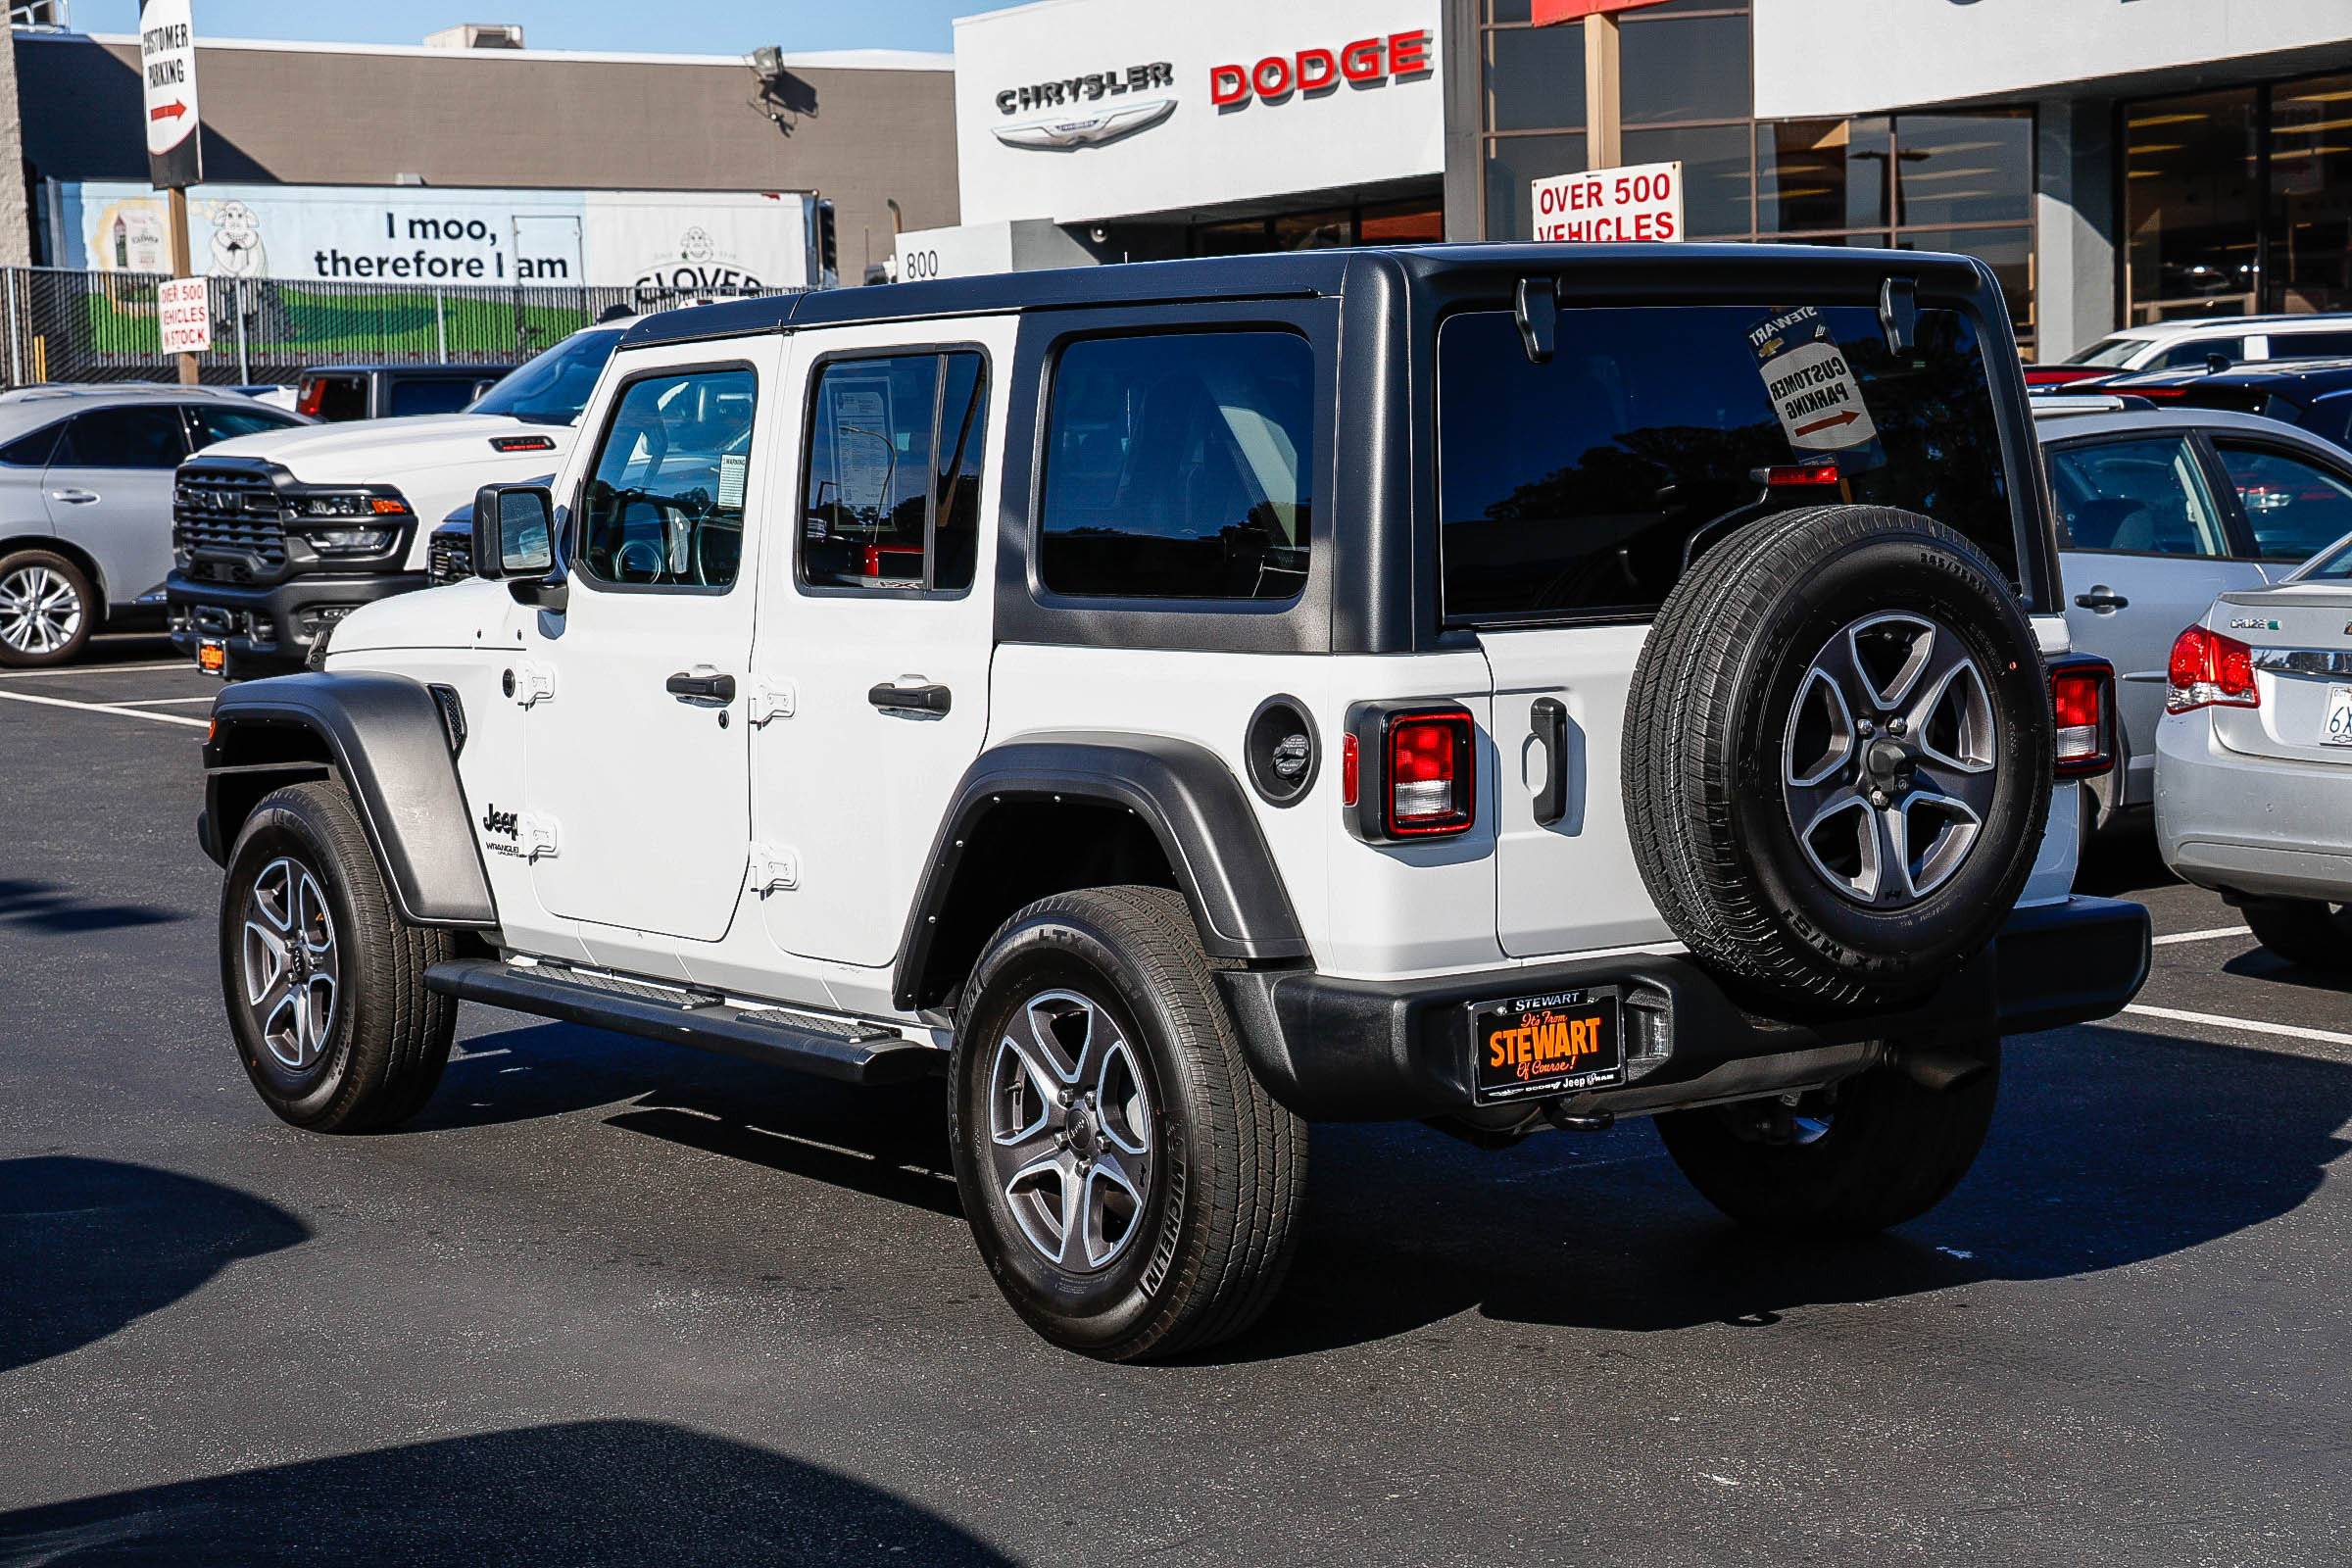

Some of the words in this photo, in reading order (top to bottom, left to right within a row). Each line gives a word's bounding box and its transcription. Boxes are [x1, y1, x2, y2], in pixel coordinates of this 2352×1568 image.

[143, 24, 188, 56] CUSTOMER
[148, 59, 184, 89] PARKING
[1210, 29, 1433, 112] DODGE
[996, 62, 1173, 115] CHRYSLER
[1541, 182, 1603, 214] OVER
[1615, 173, 1670, 205] 500
[409, 218, 497, 247] moo,
[1539, 212, 1674, 241] VEHICLES
[315, 249, 485, 278] therefore
[516, 255, 568, 278] am
[906, 251, 938, 279] 800
[182, 284, 204, 301] 500
[483, 803, 518, 841] Jeep
[486, 842, 518, 854] WRANGLE
[1515, 992, 1580, 1011] STEWART
[1542, 1010, 1568, 1025] From
[1490, 1017, 1601, 1067] STEWART
[1516, 1061, 1530, 1081] Of
[1562, 1078, 1585, 1088] Jeep
